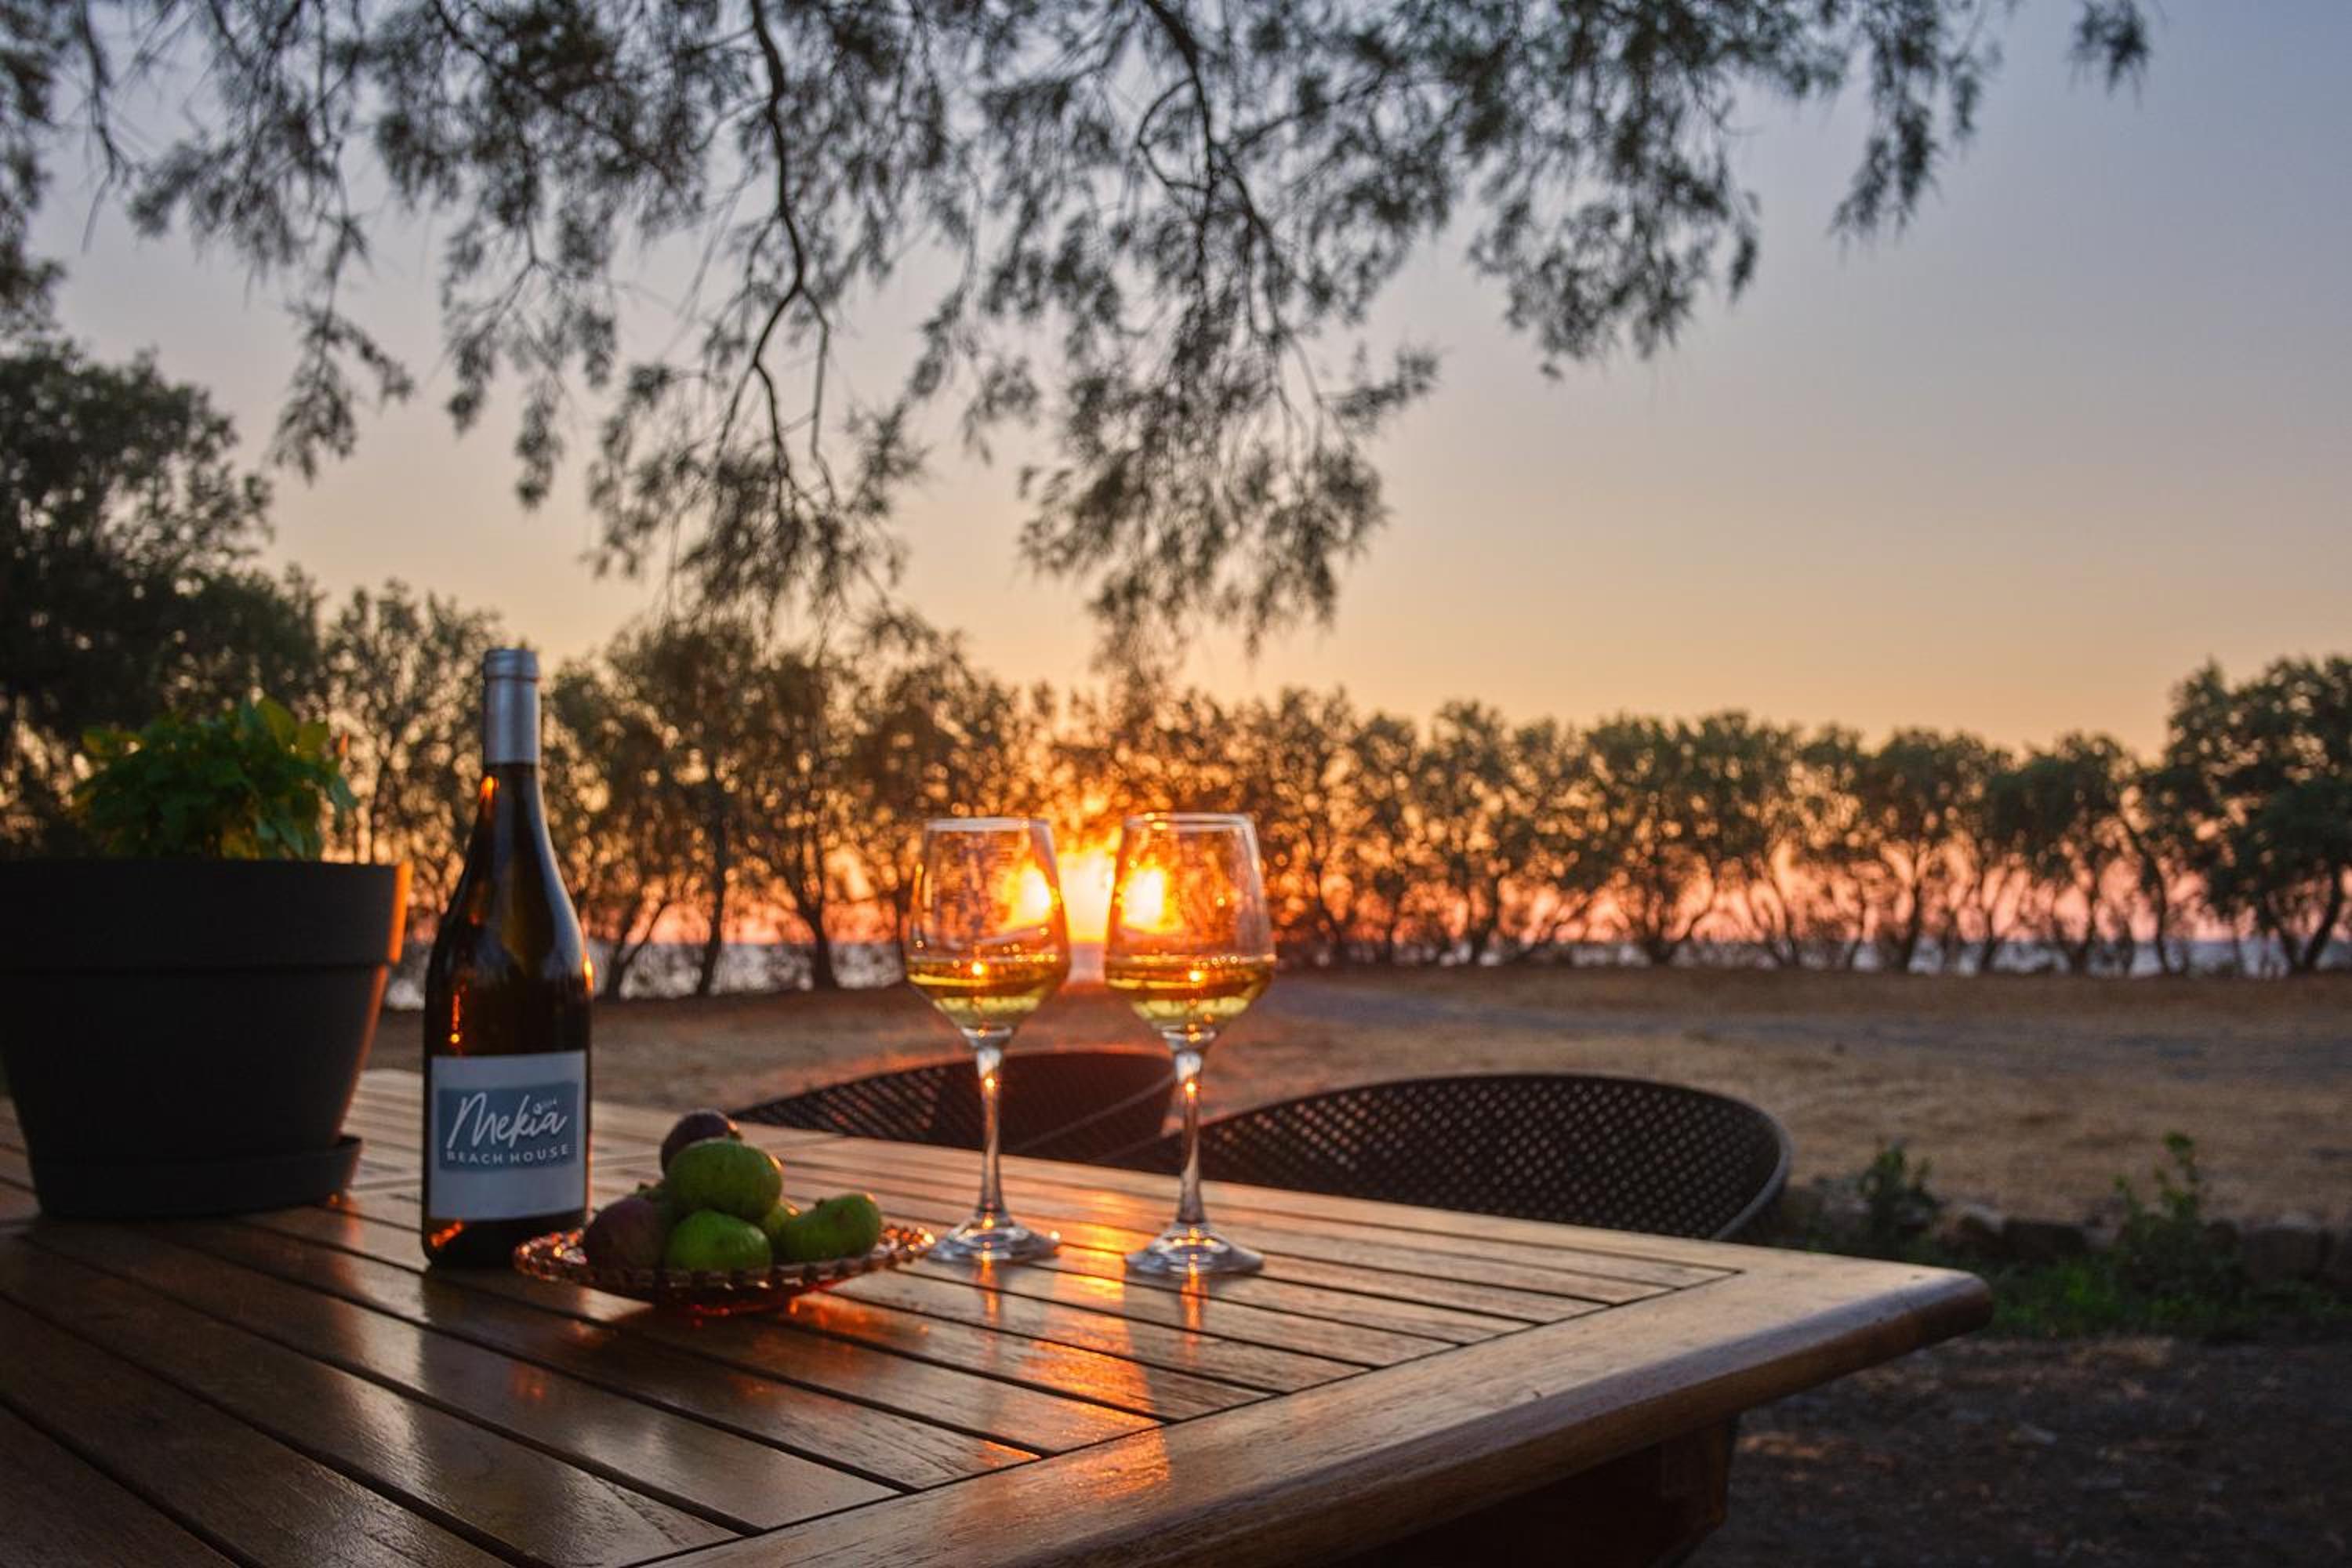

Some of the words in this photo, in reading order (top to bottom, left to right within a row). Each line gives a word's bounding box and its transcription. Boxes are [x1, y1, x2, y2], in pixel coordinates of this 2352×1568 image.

[446, 1091, 568, 1149] Mekia
[446, 1150, 503, 1165] BEACH
[510, 1144, 569, 1163] HOUSE
